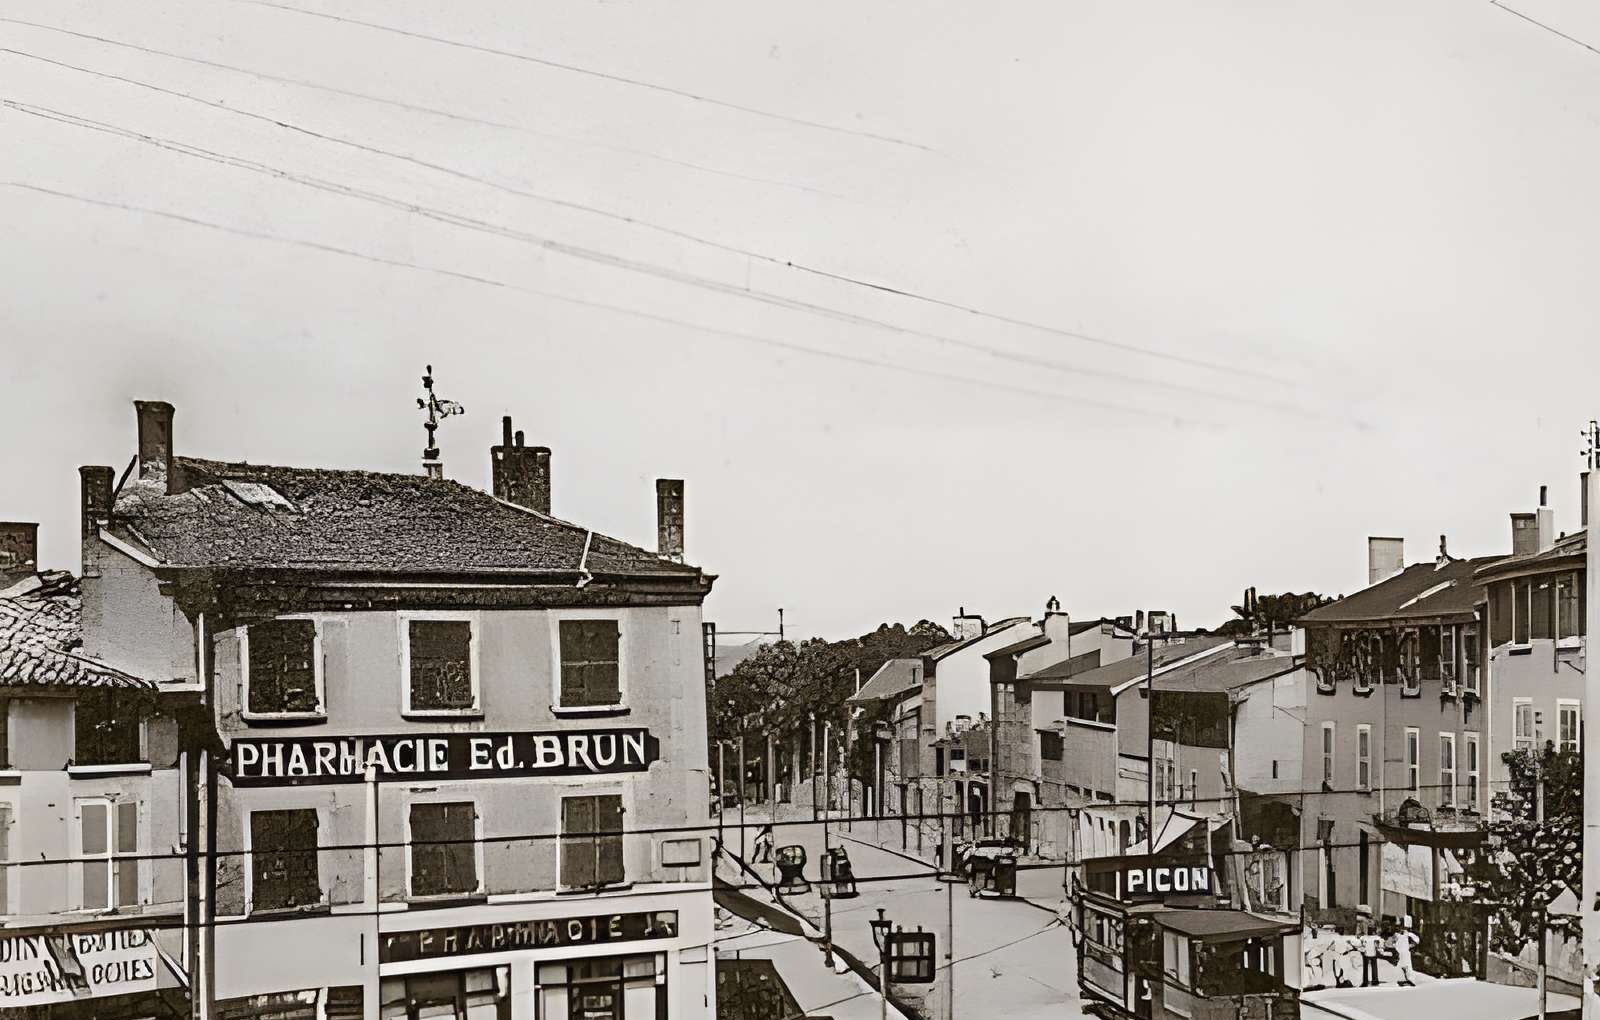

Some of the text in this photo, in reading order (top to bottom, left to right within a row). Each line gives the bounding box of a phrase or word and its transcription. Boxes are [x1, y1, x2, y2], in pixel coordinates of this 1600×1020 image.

[468, 736, 524, 770] Ed.
[532, 732, 646, 773] BRUN
[1127, 866, 1209, 893] PICON
